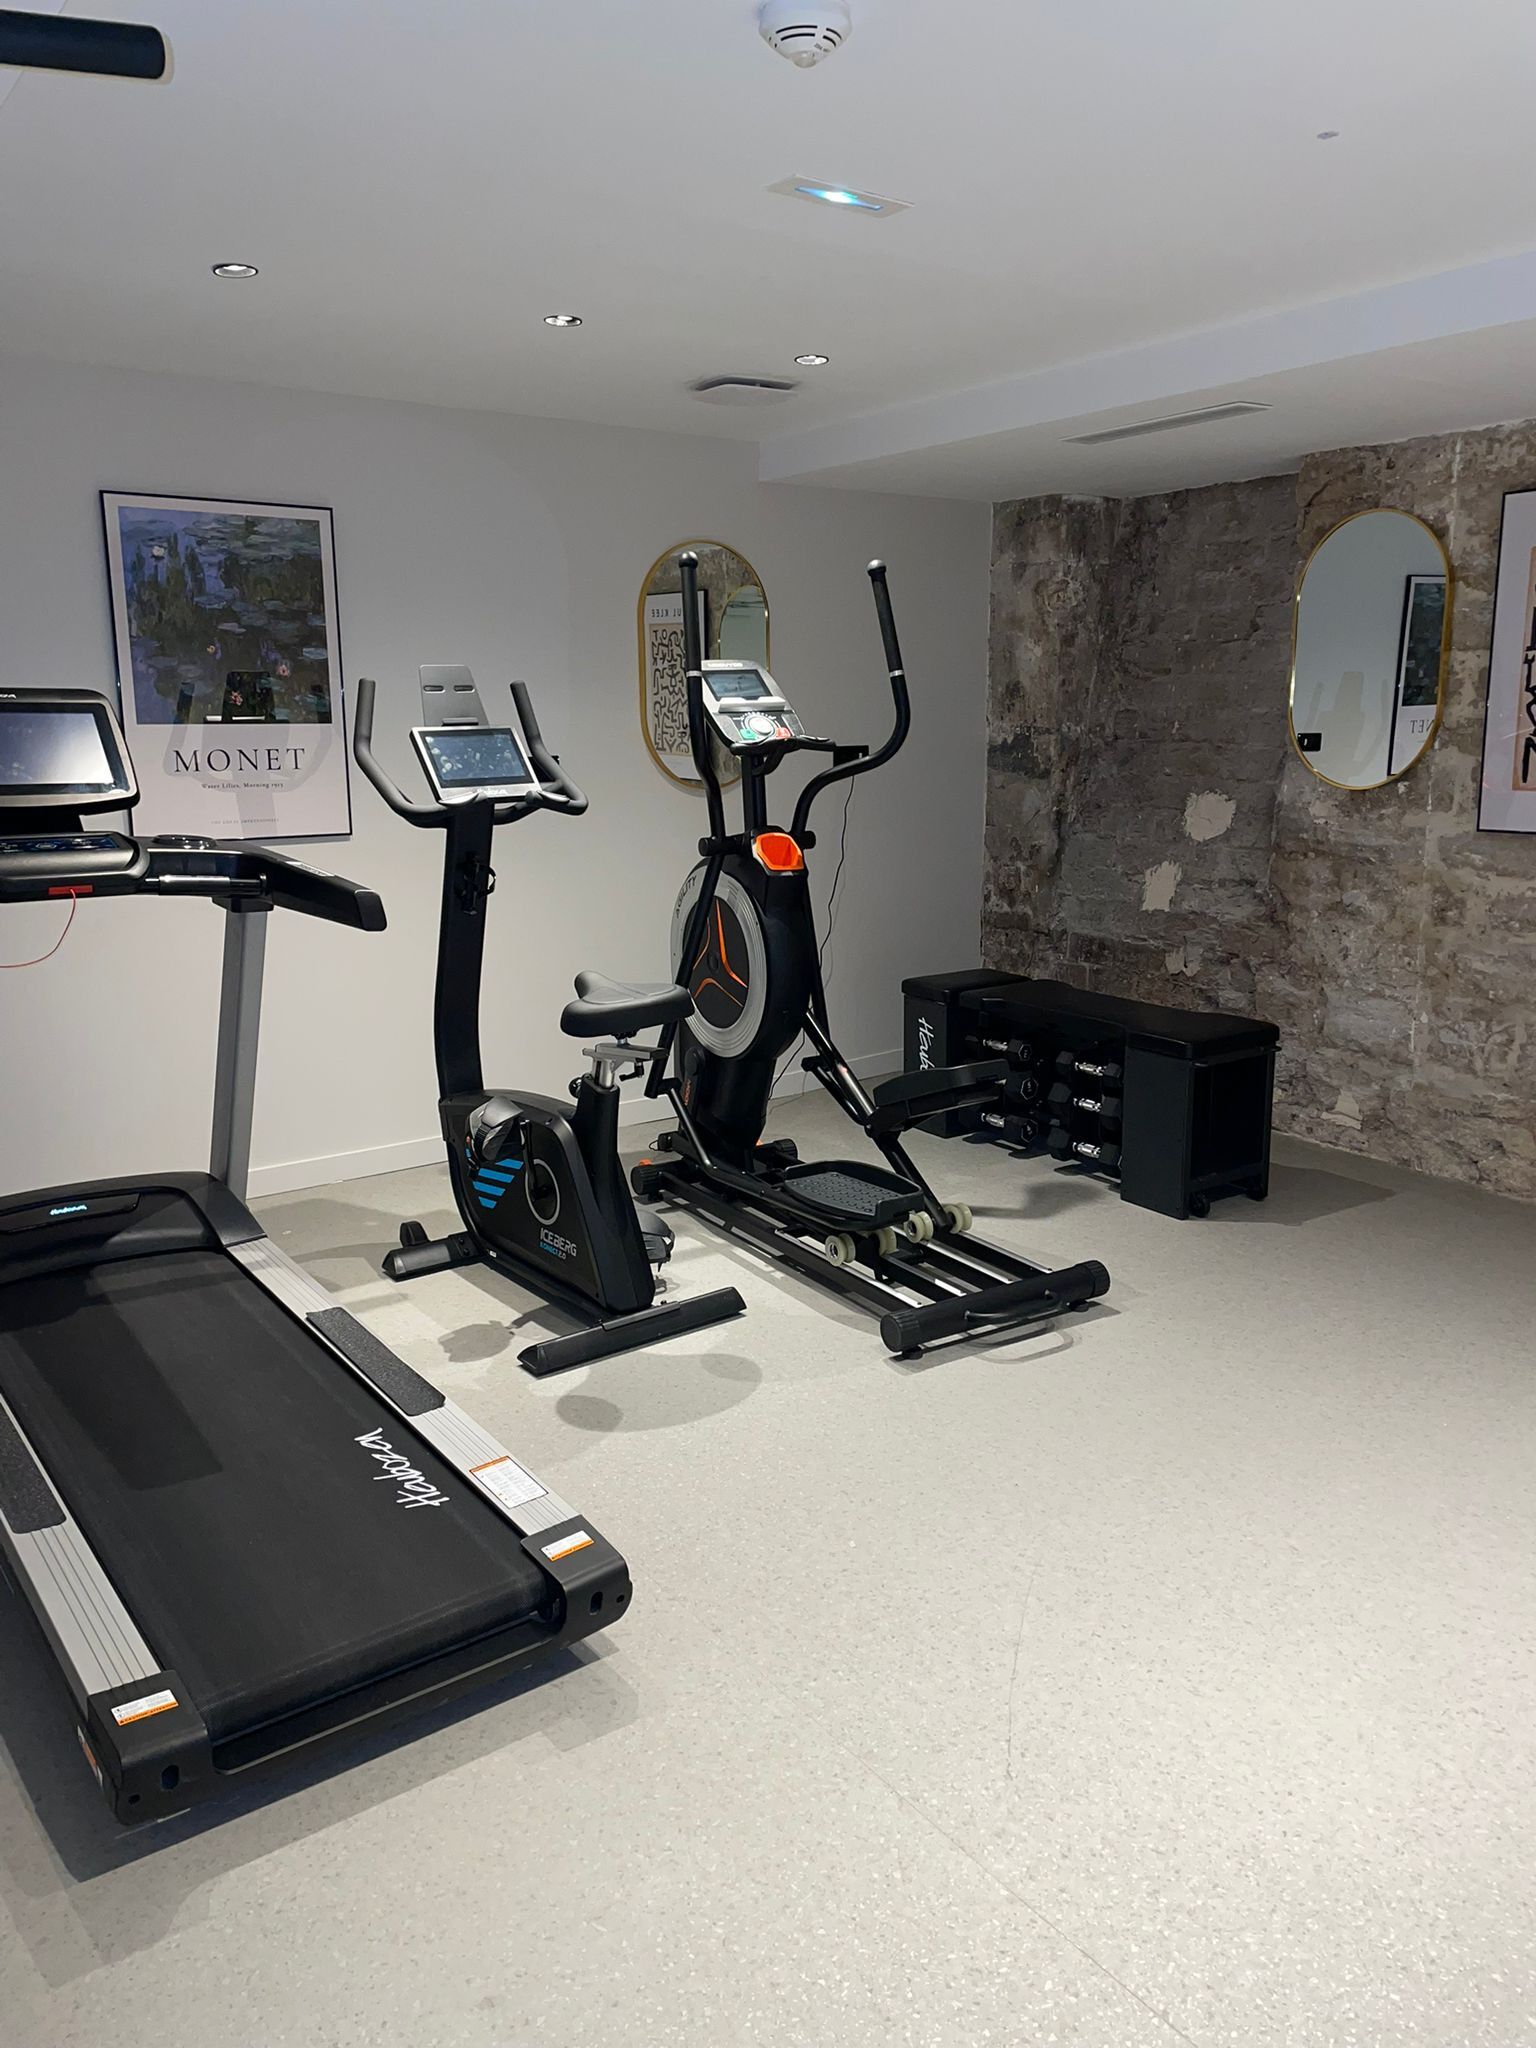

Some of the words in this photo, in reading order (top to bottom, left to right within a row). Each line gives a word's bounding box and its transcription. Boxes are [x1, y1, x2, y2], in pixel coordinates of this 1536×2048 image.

[173, 748, 305, 773] MONET
[918, 1016, 935, 1071] Heub
[540, 1227, 577, 1257] ICEBERG
